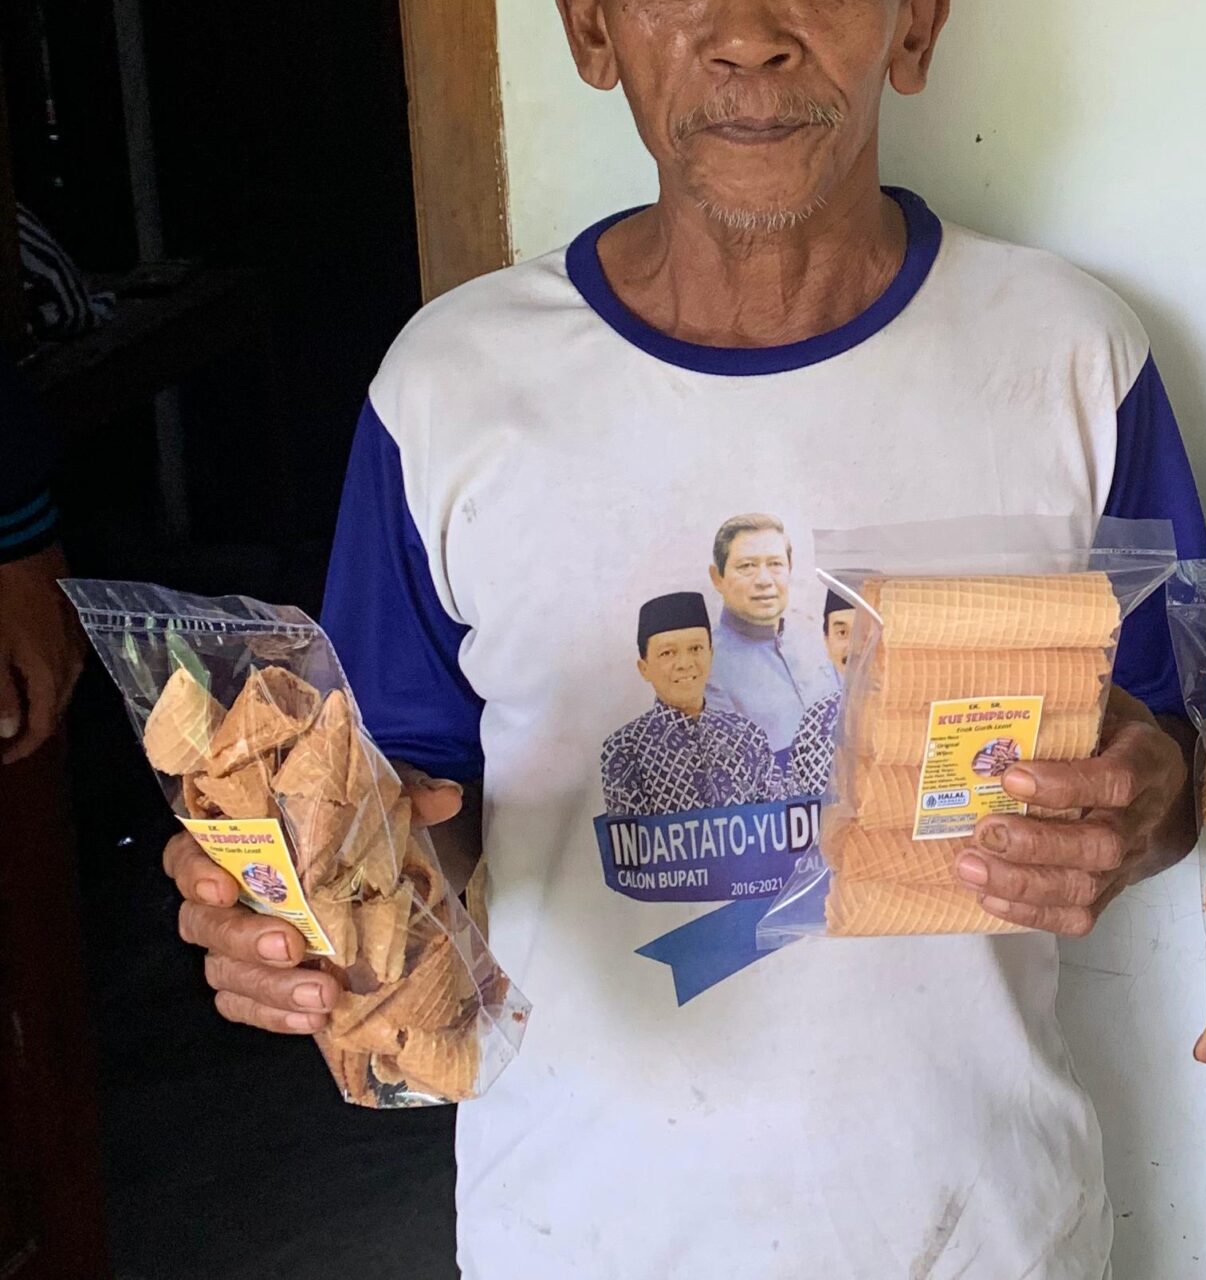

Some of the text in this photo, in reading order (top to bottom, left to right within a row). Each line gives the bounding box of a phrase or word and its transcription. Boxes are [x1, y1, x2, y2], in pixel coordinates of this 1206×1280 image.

[938, 792, 965, 800] HALAL
[618, 868, 708, 889] CALON BUPATI
[731, 876, 783, 895] 2016-2021
